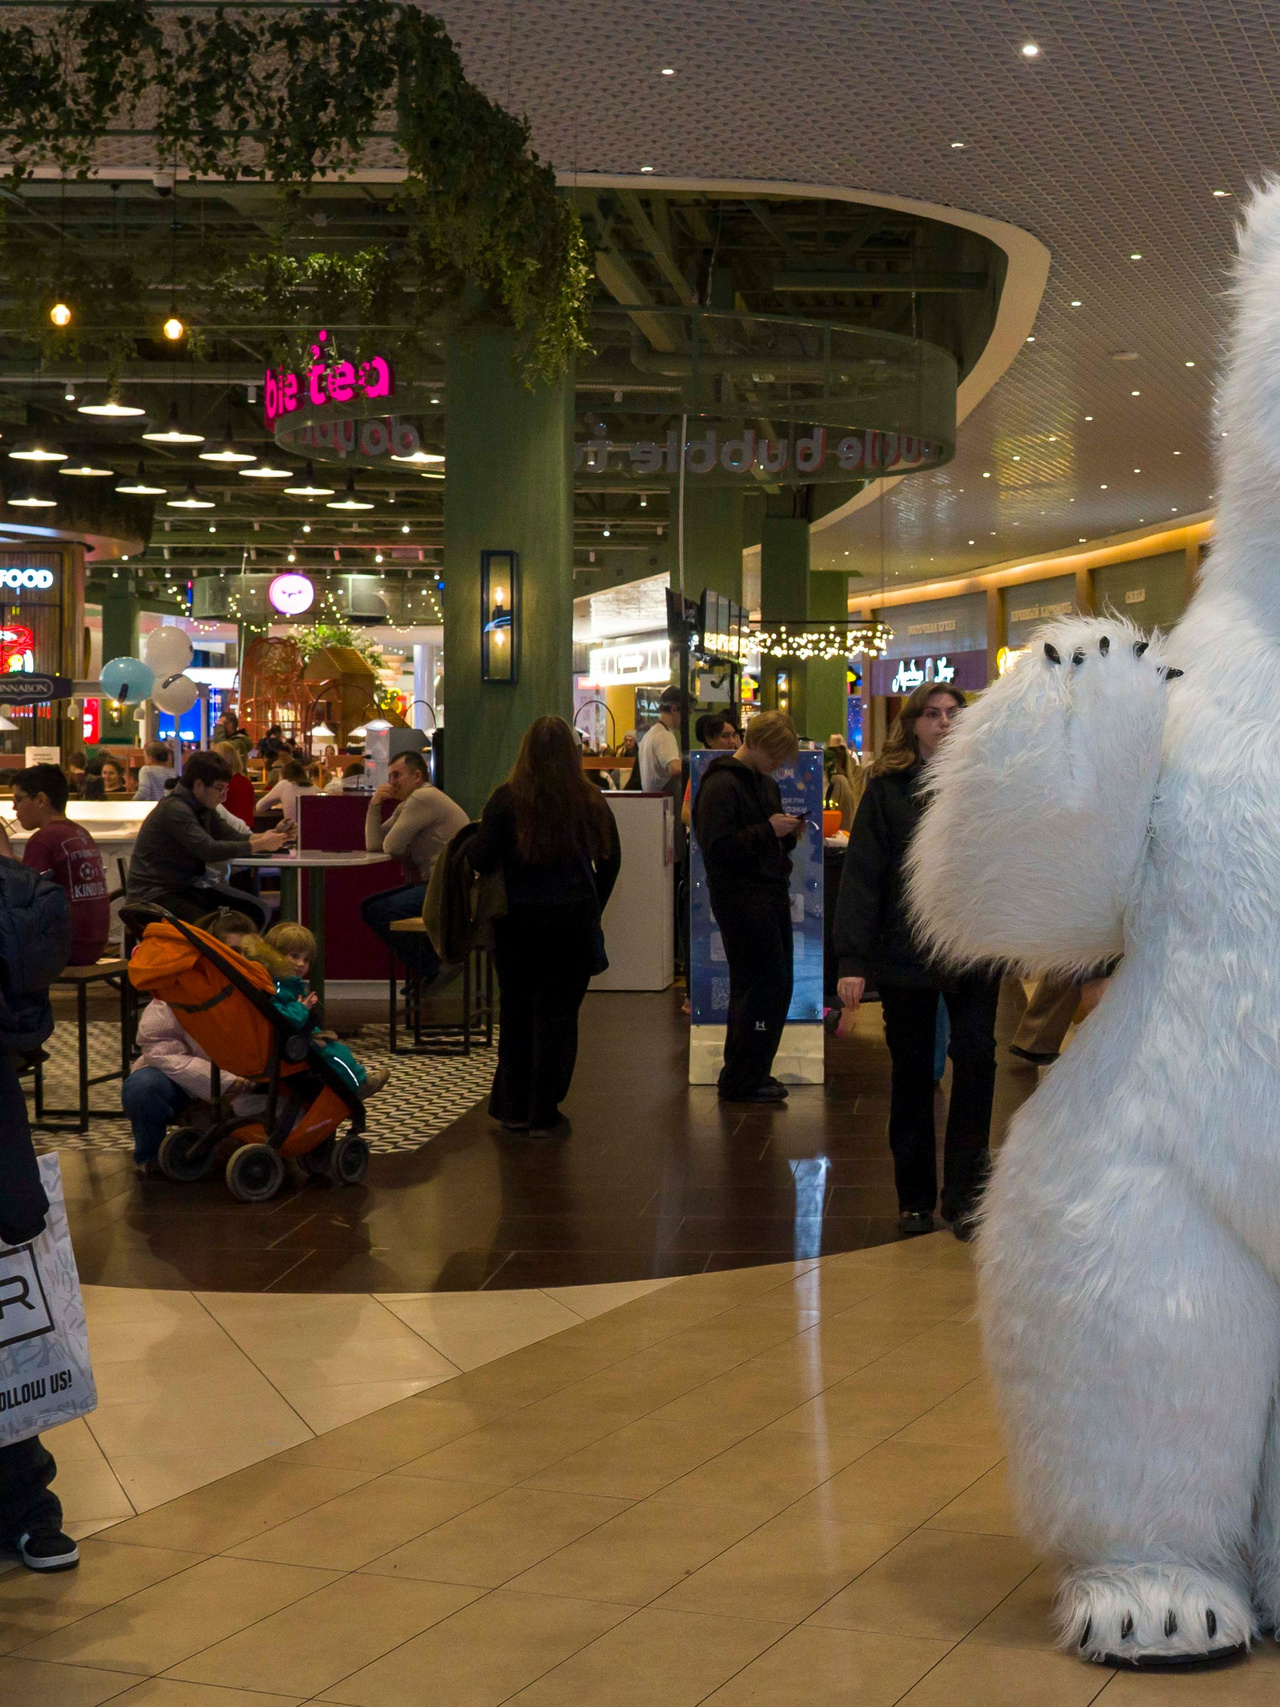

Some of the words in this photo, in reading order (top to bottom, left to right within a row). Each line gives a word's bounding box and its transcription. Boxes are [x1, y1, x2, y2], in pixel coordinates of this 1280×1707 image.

[307, 352, 390, 406] tea
[0, 1378, 46, 1412] OLLOW
[50, 1369, 72, 1394] US!
